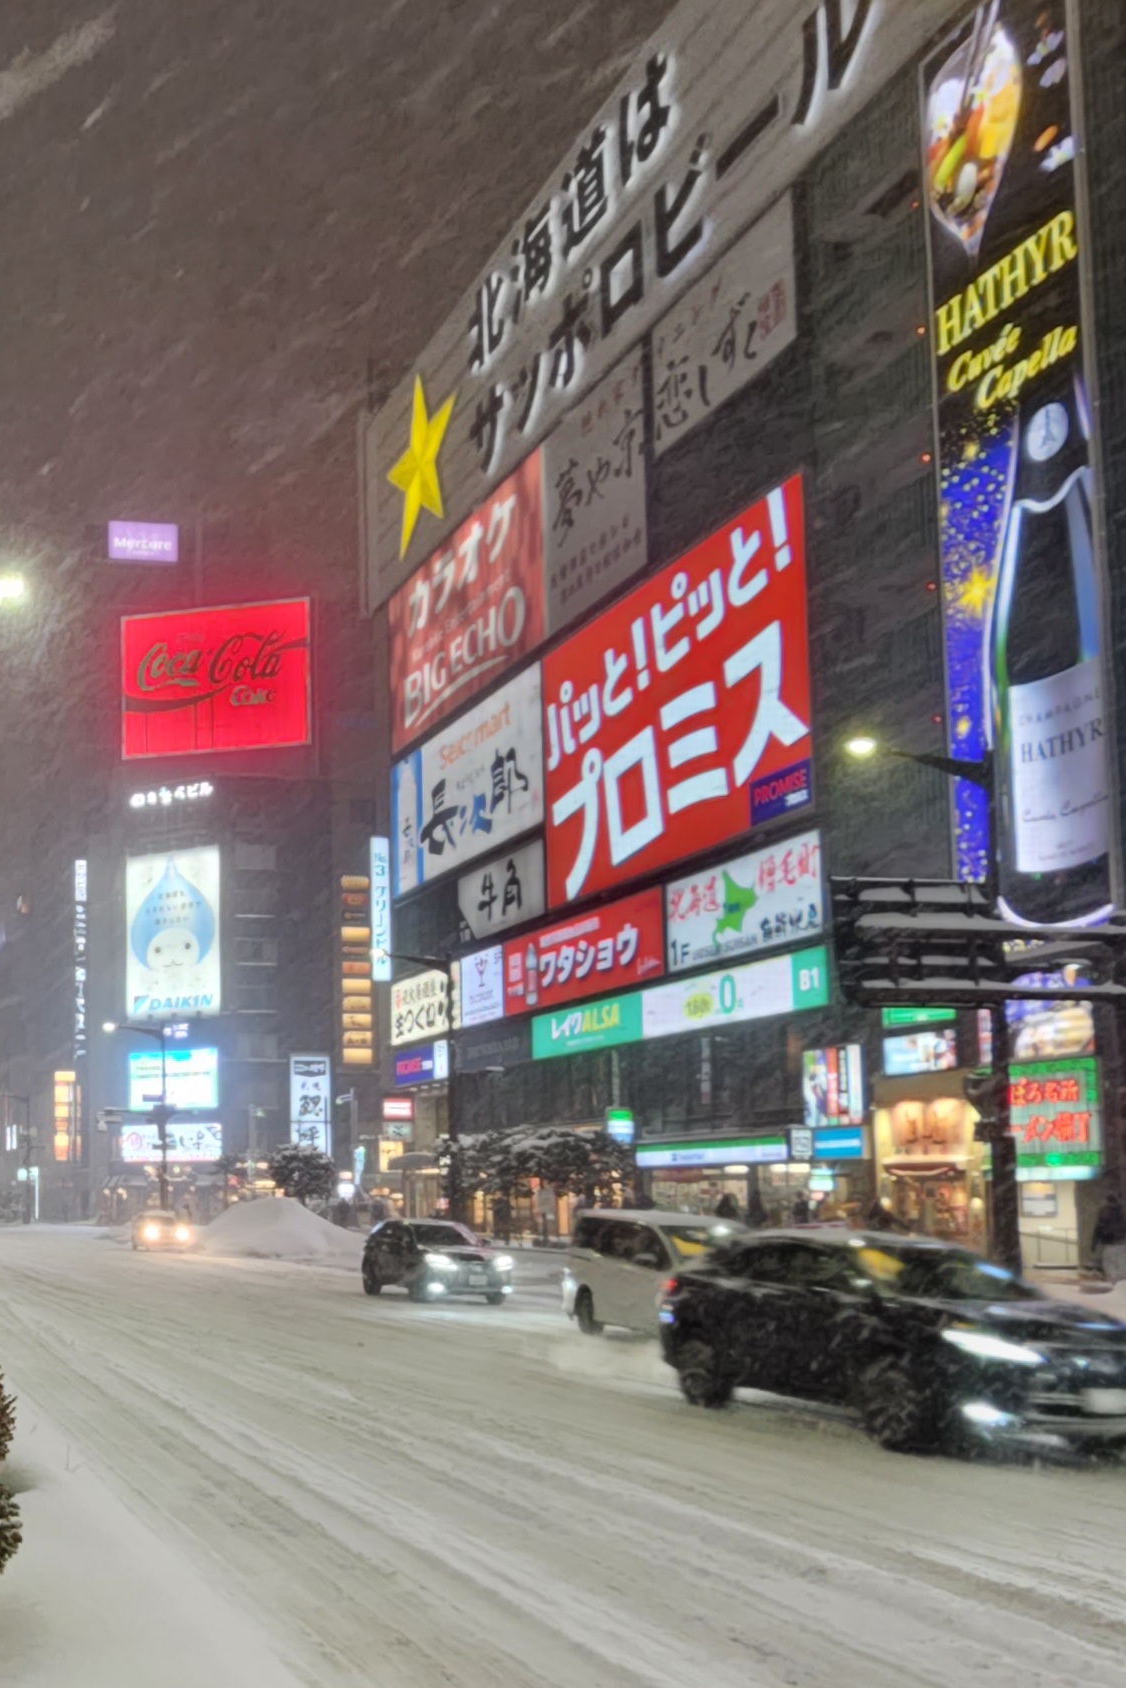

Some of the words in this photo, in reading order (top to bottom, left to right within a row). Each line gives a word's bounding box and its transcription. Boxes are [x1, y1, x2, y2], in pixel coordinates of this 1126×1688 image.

[470, 52, 674, 375] 北海道は
[471, 0, 877, 476] サッポロビール
[936, 210, 1078, 356] HATHYR
[946, 322, 1022, 393] Cuvée
[976, 325, 1078, 409] Capella
[408, 493, 516, 638] カラオケ
[404, 652, 446, 729] BIG
[450, 586, 525, 676] ECHO
[552, 620, 810, 901] プロミス
[1021, 717, 1105, 763] HATHYR
[420, 747, 530, 856] 長次郎
[754, 769, 807, 807] PROMISE
[478, 858, 522, 921] 牛角
[539, 923, 639, 988] ワタショウ
[671, 939, 690, 966] 1F
[799, 966, 820, 991] B1
[149, 993, 214, 1010] DAIKIN
